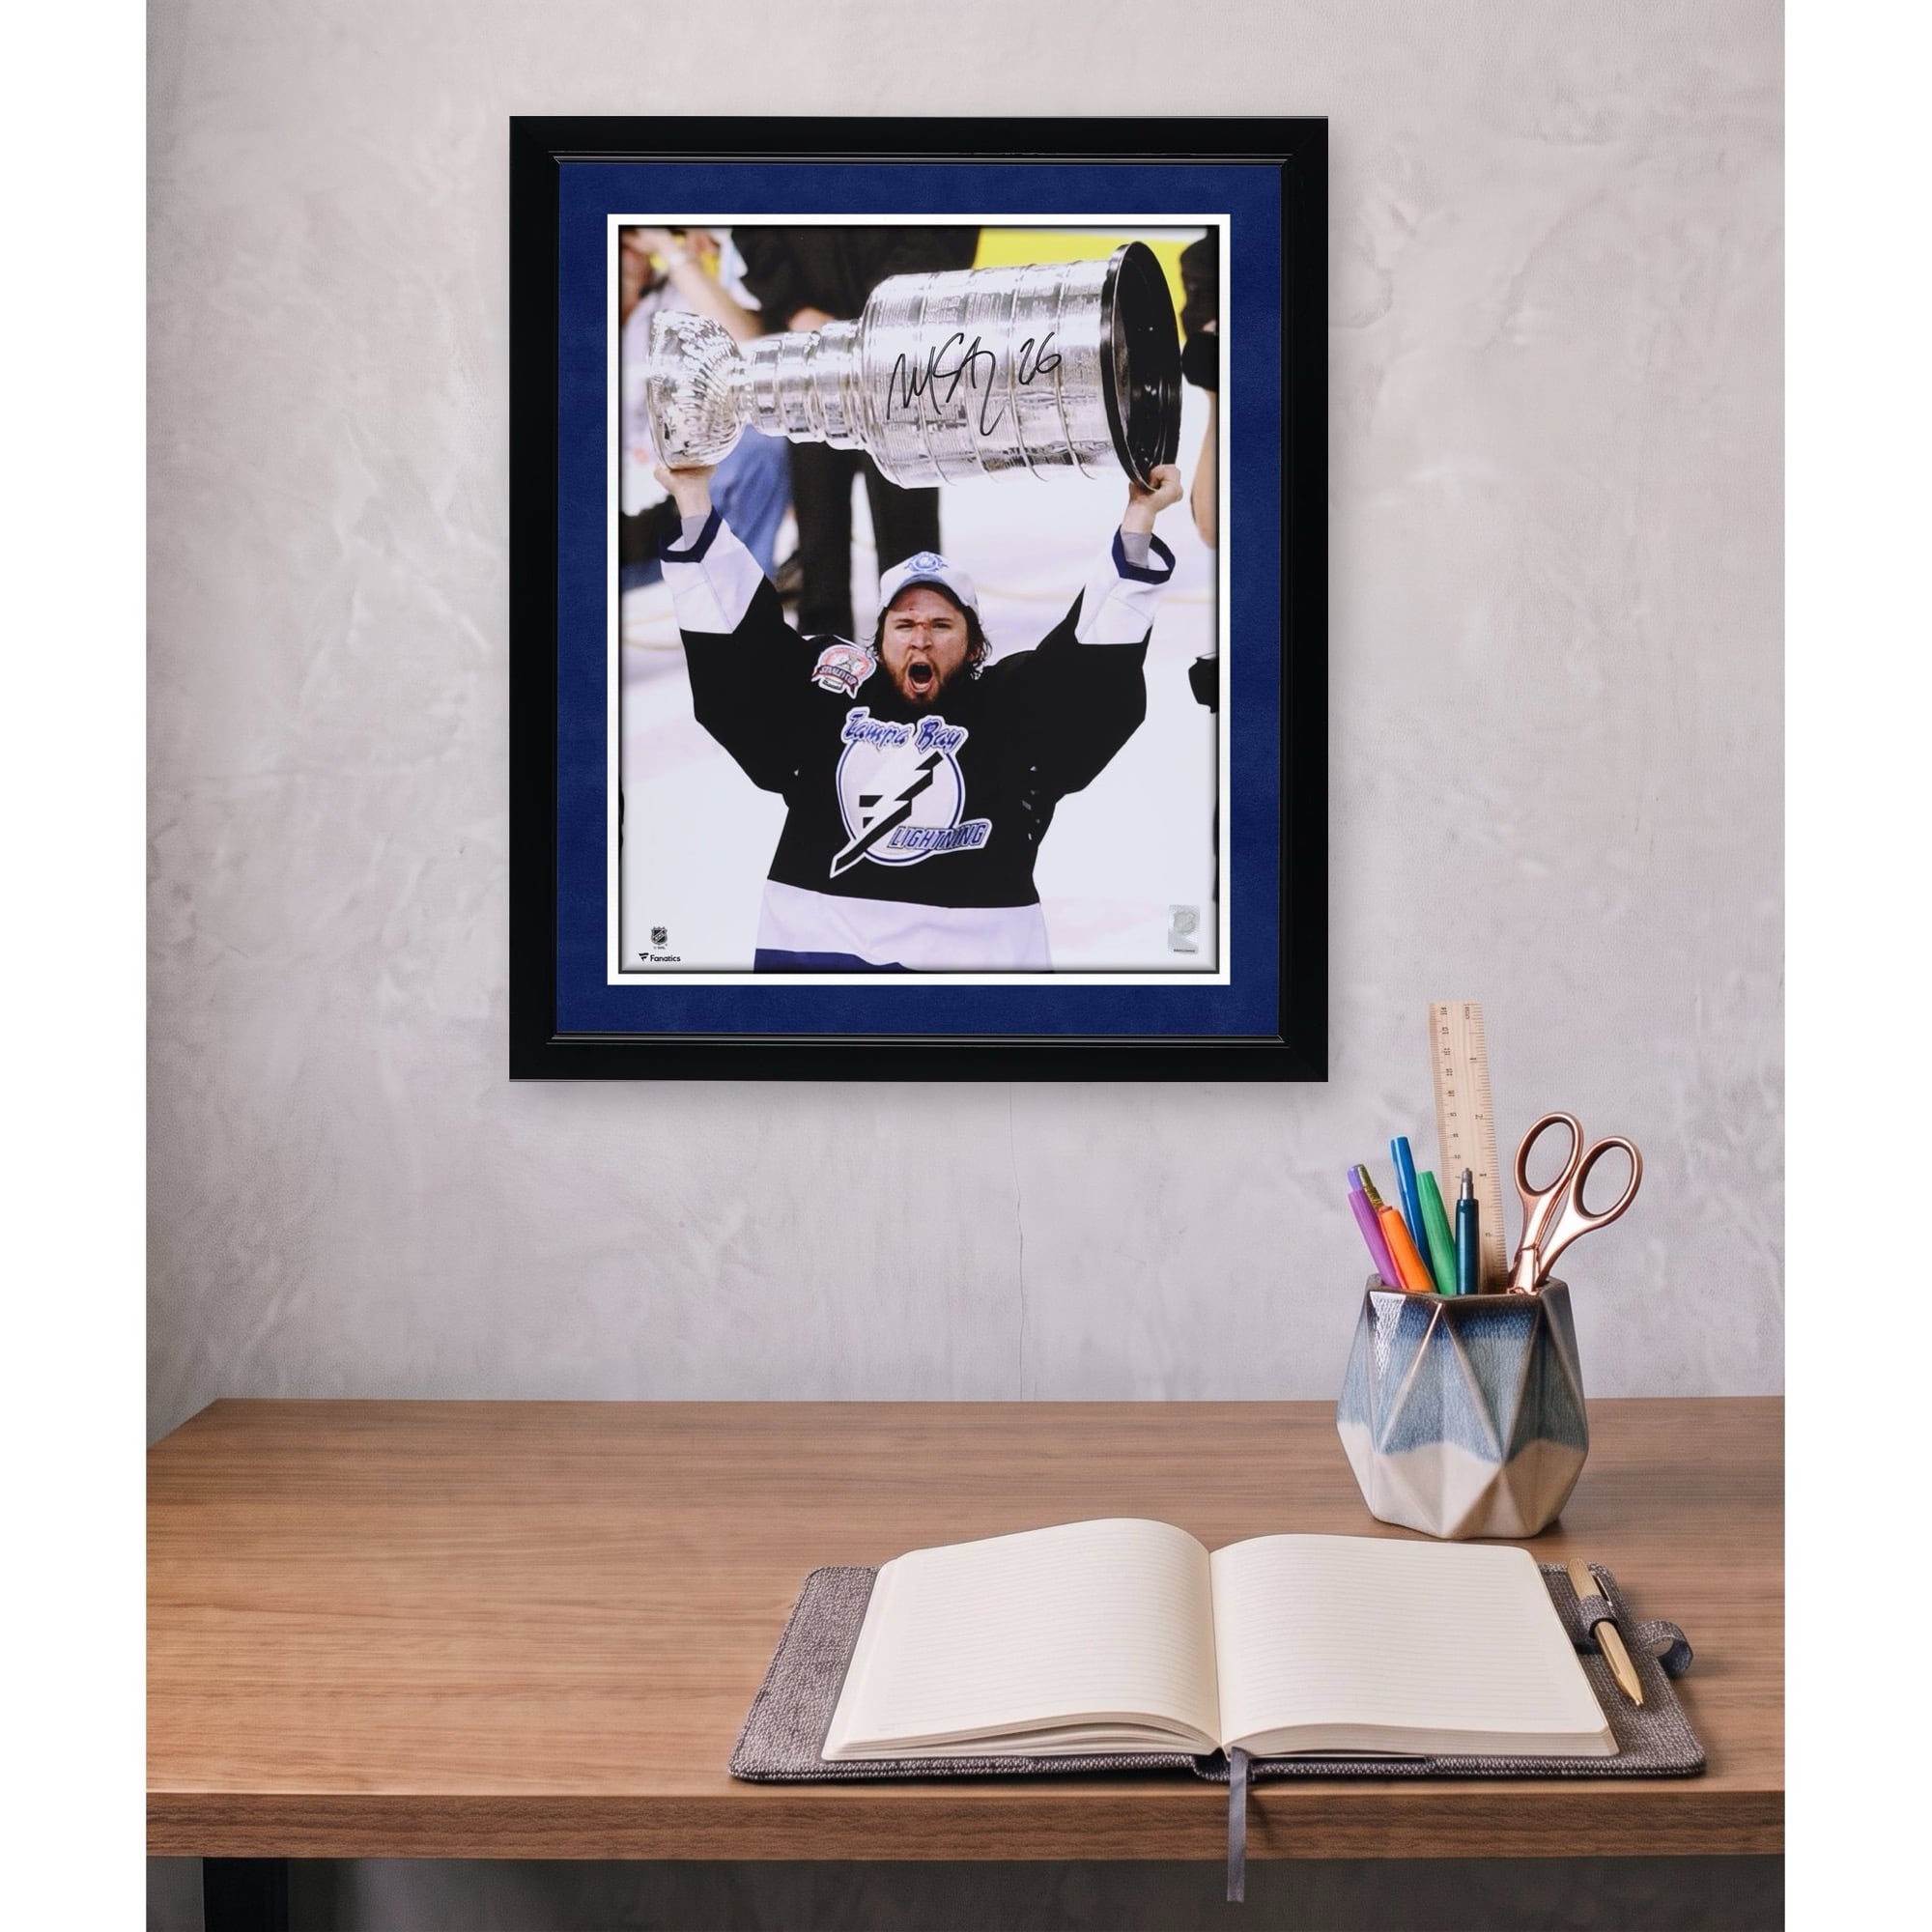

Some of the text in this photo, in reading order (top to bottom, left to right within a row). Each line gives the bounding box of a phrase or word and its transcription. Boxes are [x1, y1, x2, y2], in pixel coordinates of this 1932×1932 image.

[1018, 331, 1063, 385] 26
[843, 710, 964, 753] Tampa Bay
[888, 822, 989, 850] LIGHTNING
